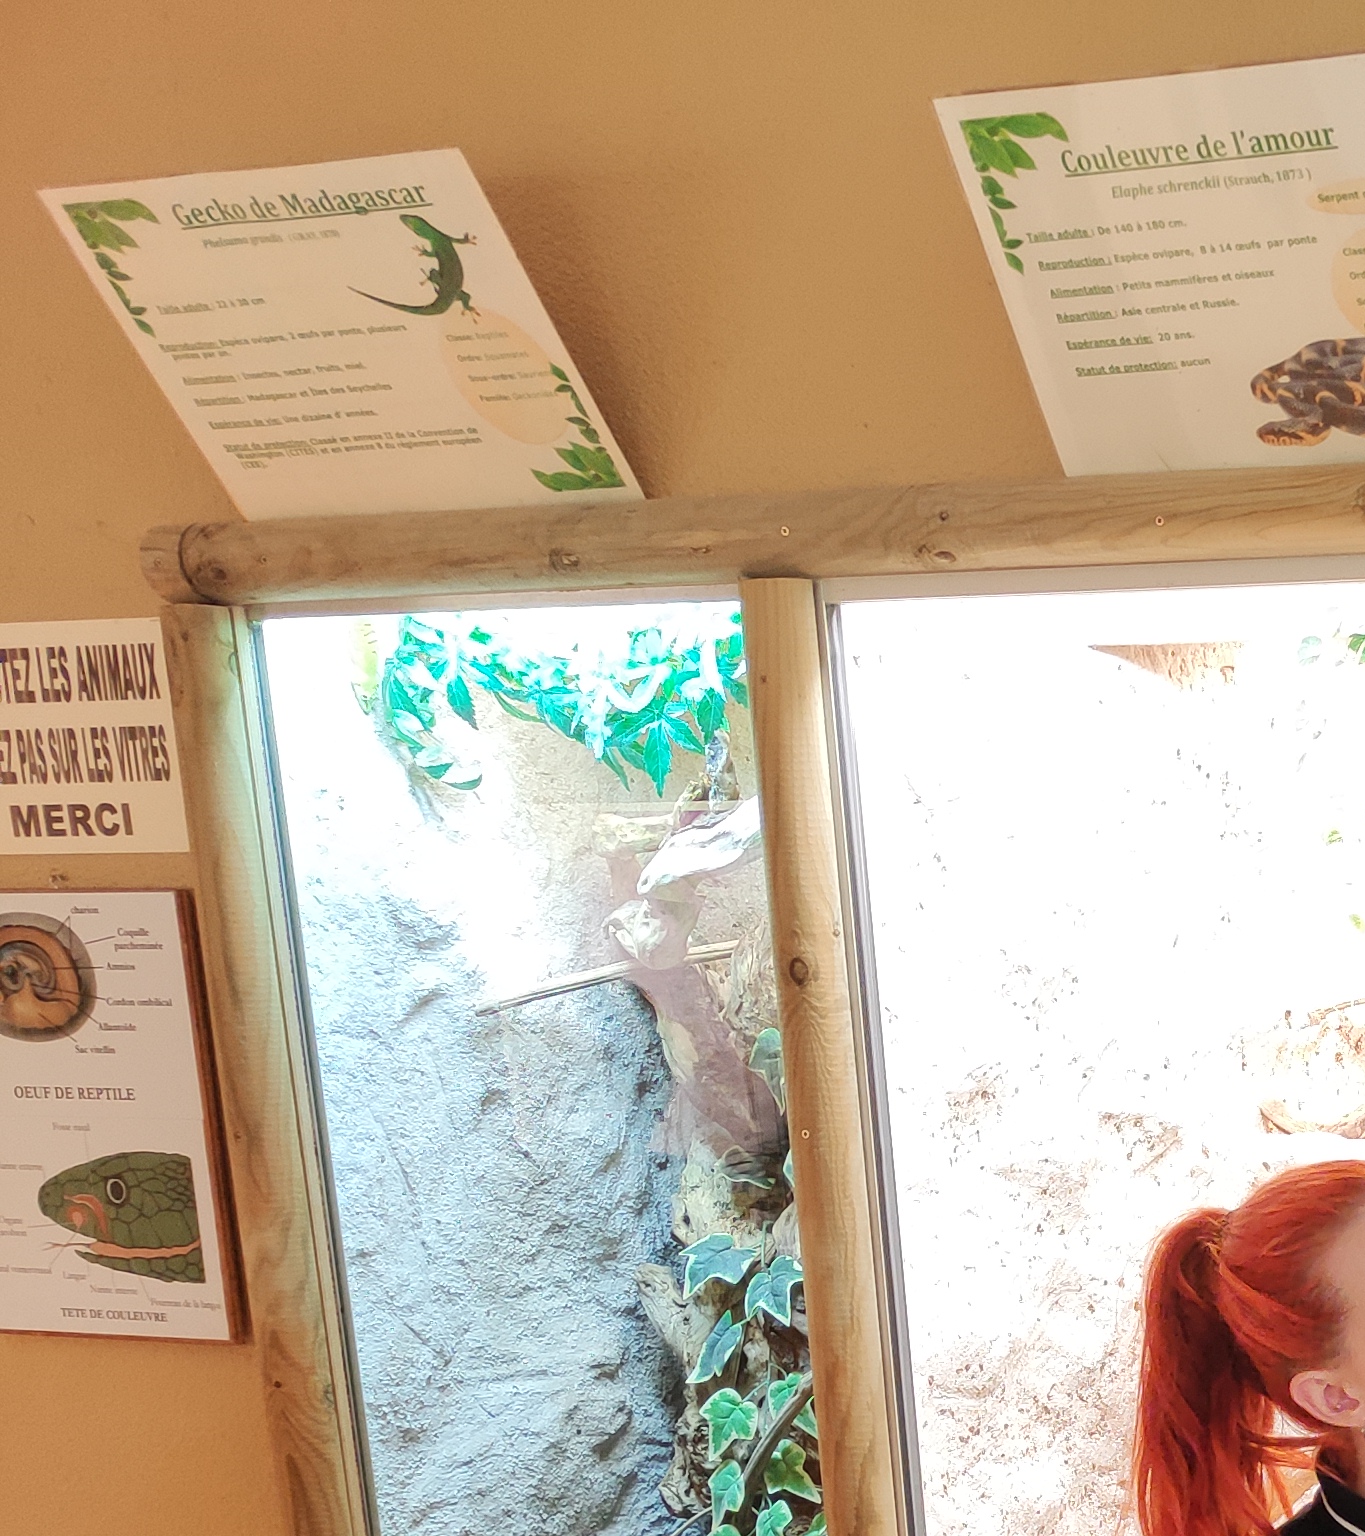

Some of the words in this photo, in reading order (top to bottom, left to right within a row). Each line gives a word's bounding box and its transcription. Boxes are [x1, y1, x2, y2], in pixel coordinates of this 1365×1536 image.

[1061, 144, 1190, 175] Couleuvre
[1196, 135, 1227, 160] de
[1231, 126, 1336, 156] l'amour
[1112, 184, 1154, 201] Elaphe
[1157, 176, 1221, 196] schrenckii
[1223, 171, 1274, 190] (Strauch,
[1318, 191, 1359, 204] Serpent
[172, 199, 247, 227] Gecko
[250, 196, 280, 220] de
[278, 184, 428, 216] Madagascar
[1026, 231, 1053, 243] Taille
[1057, 228, 1089, 240] adulte
[1114, 223, 1133, 234] 140
[1113, 251, 1150, 264] Espèce
[1152, 247, 1194, 261] ovipare,
[1267, 239, 1284, 250] par
[1287, 235, 1318, 248] ponte
[1050, 283, 1114, 299] Alimentation
[1122, 281, 1152, 292] Petits
[1155, 274, 1219, 288] mammifères
[1235, 269, 1275, 280] oiseaux
[1056, 309, 1112, 324] Répartition
[1145, 303, 1187, 316] centrale
[1203, 298, 1240, 310] Russie.
[1066, 336, 1117, 351] Espérance
[1075, 366, 1107, 377] Statut
[1180, 357, 1211, 368] aucun
[35, 646, 72, 703] LES
[76, 643, 161, 701] ANIMAUX
[15, 728, 47, 785] PAS
[48, 727, 83, 784] SUR
[81, 726, 114, 783] LES
[112, 724, 170, 782] VITRES
[10, 803, 134, 837] MERCI
[14, 1086, 51, 1099] OEUF
[55, 1087, 74, 1099] DE
[78, 1088, 136, 1101] REPTILE
[60, 1308, 88, 1319] TETE
[106, 1310, 168, 1322] COULEUVRE
